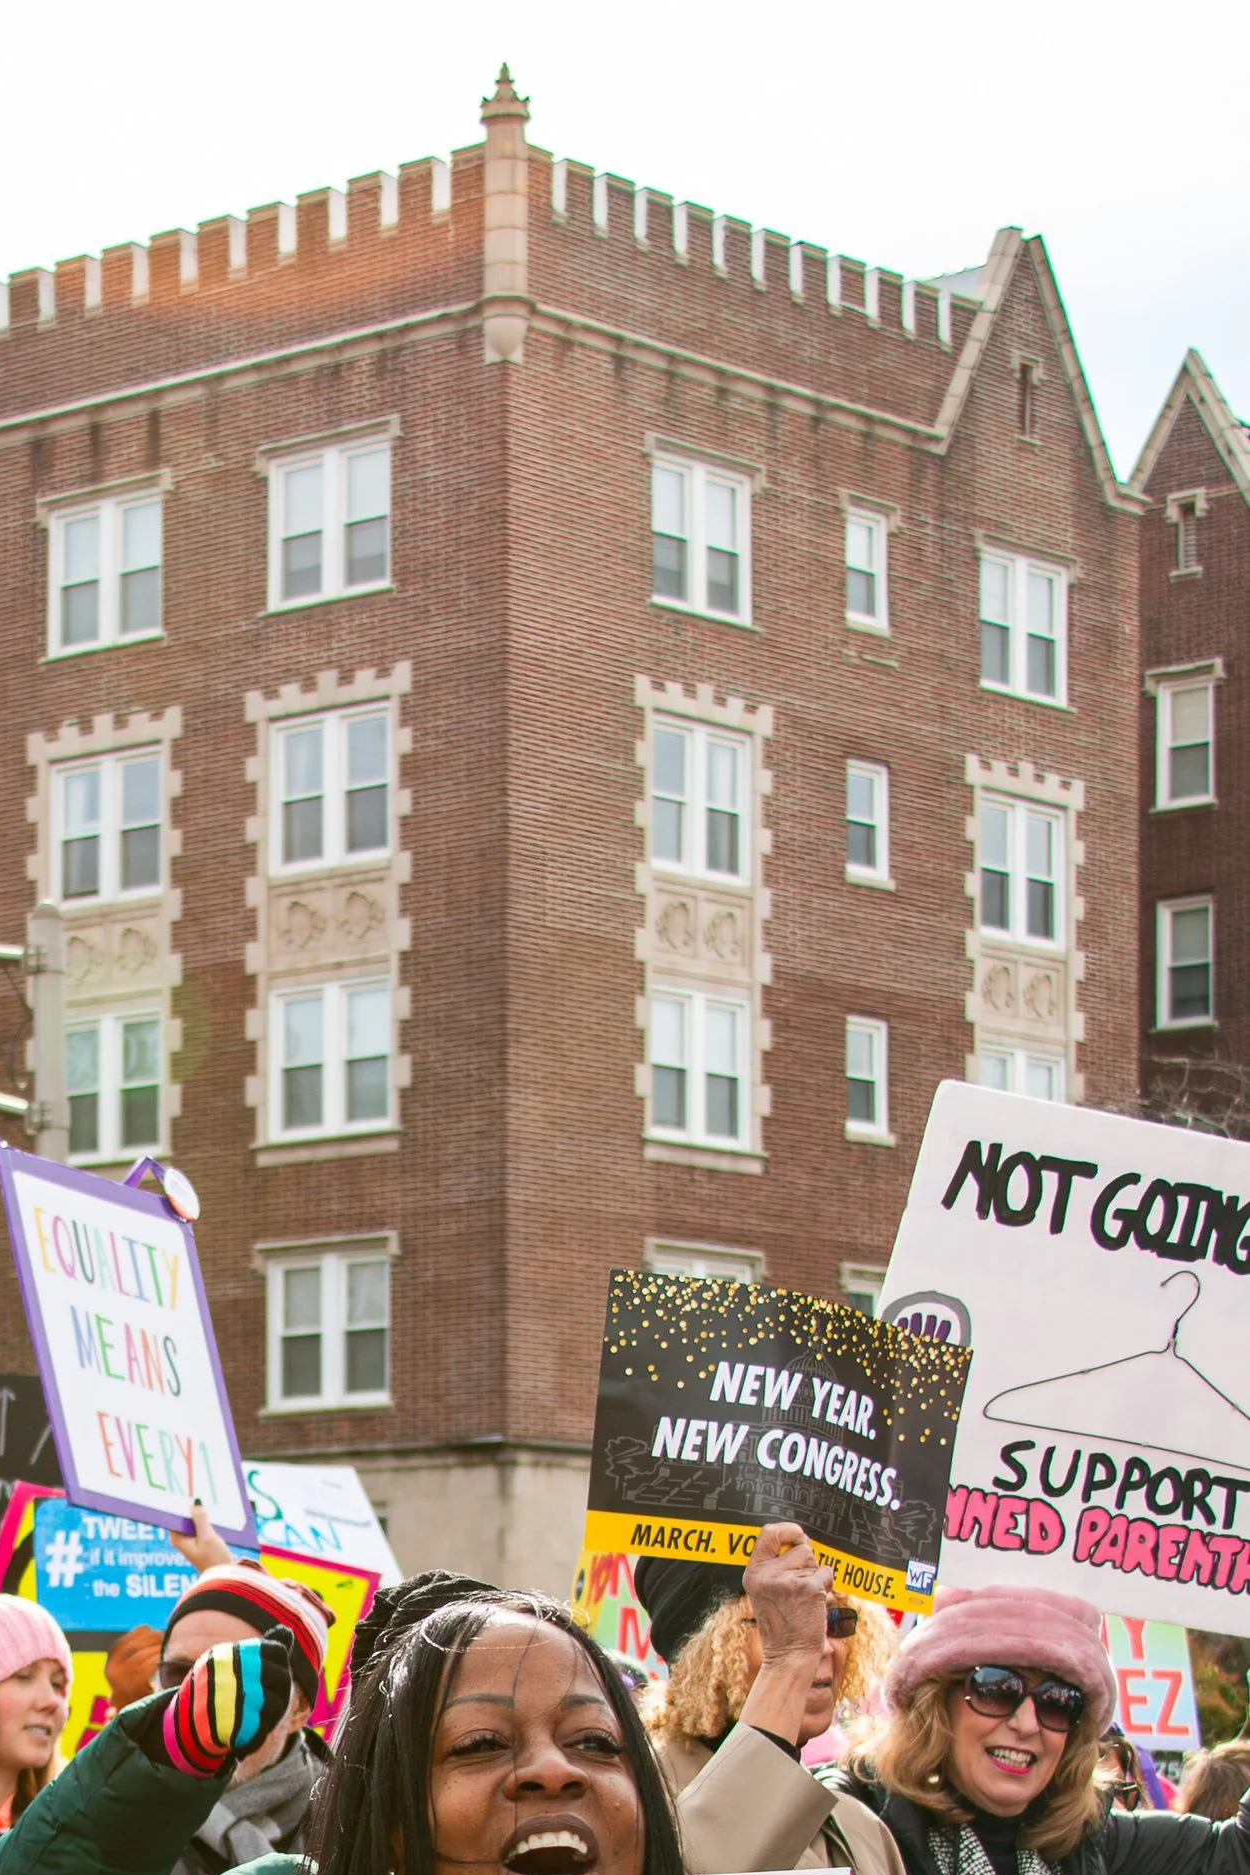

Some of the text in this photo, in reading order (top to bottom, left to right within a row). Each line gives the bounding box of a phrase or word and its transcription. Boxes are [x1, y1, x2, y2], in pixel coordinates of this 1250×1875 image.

[940, 1140, 1098, 1235] NOT
[33, 1206, 180, 1311] EQUALITY
[70, 1304, 181, 1397] MEANS
[709, 1360, 877, 1440] NEW YEAR.
[651, 1416, 901, 1511] NEW CONGRESS.
[992, 1439, 1250, 1529] SUPPORT
[90, 1548, 101, 1566] if
[104, 1548, 115, 1566] it
[93, 1579, 121, 1598] the
[630, 1522, 717, 1554] MARCH.
[841, 1565, 896, 1600] HOUSE.
